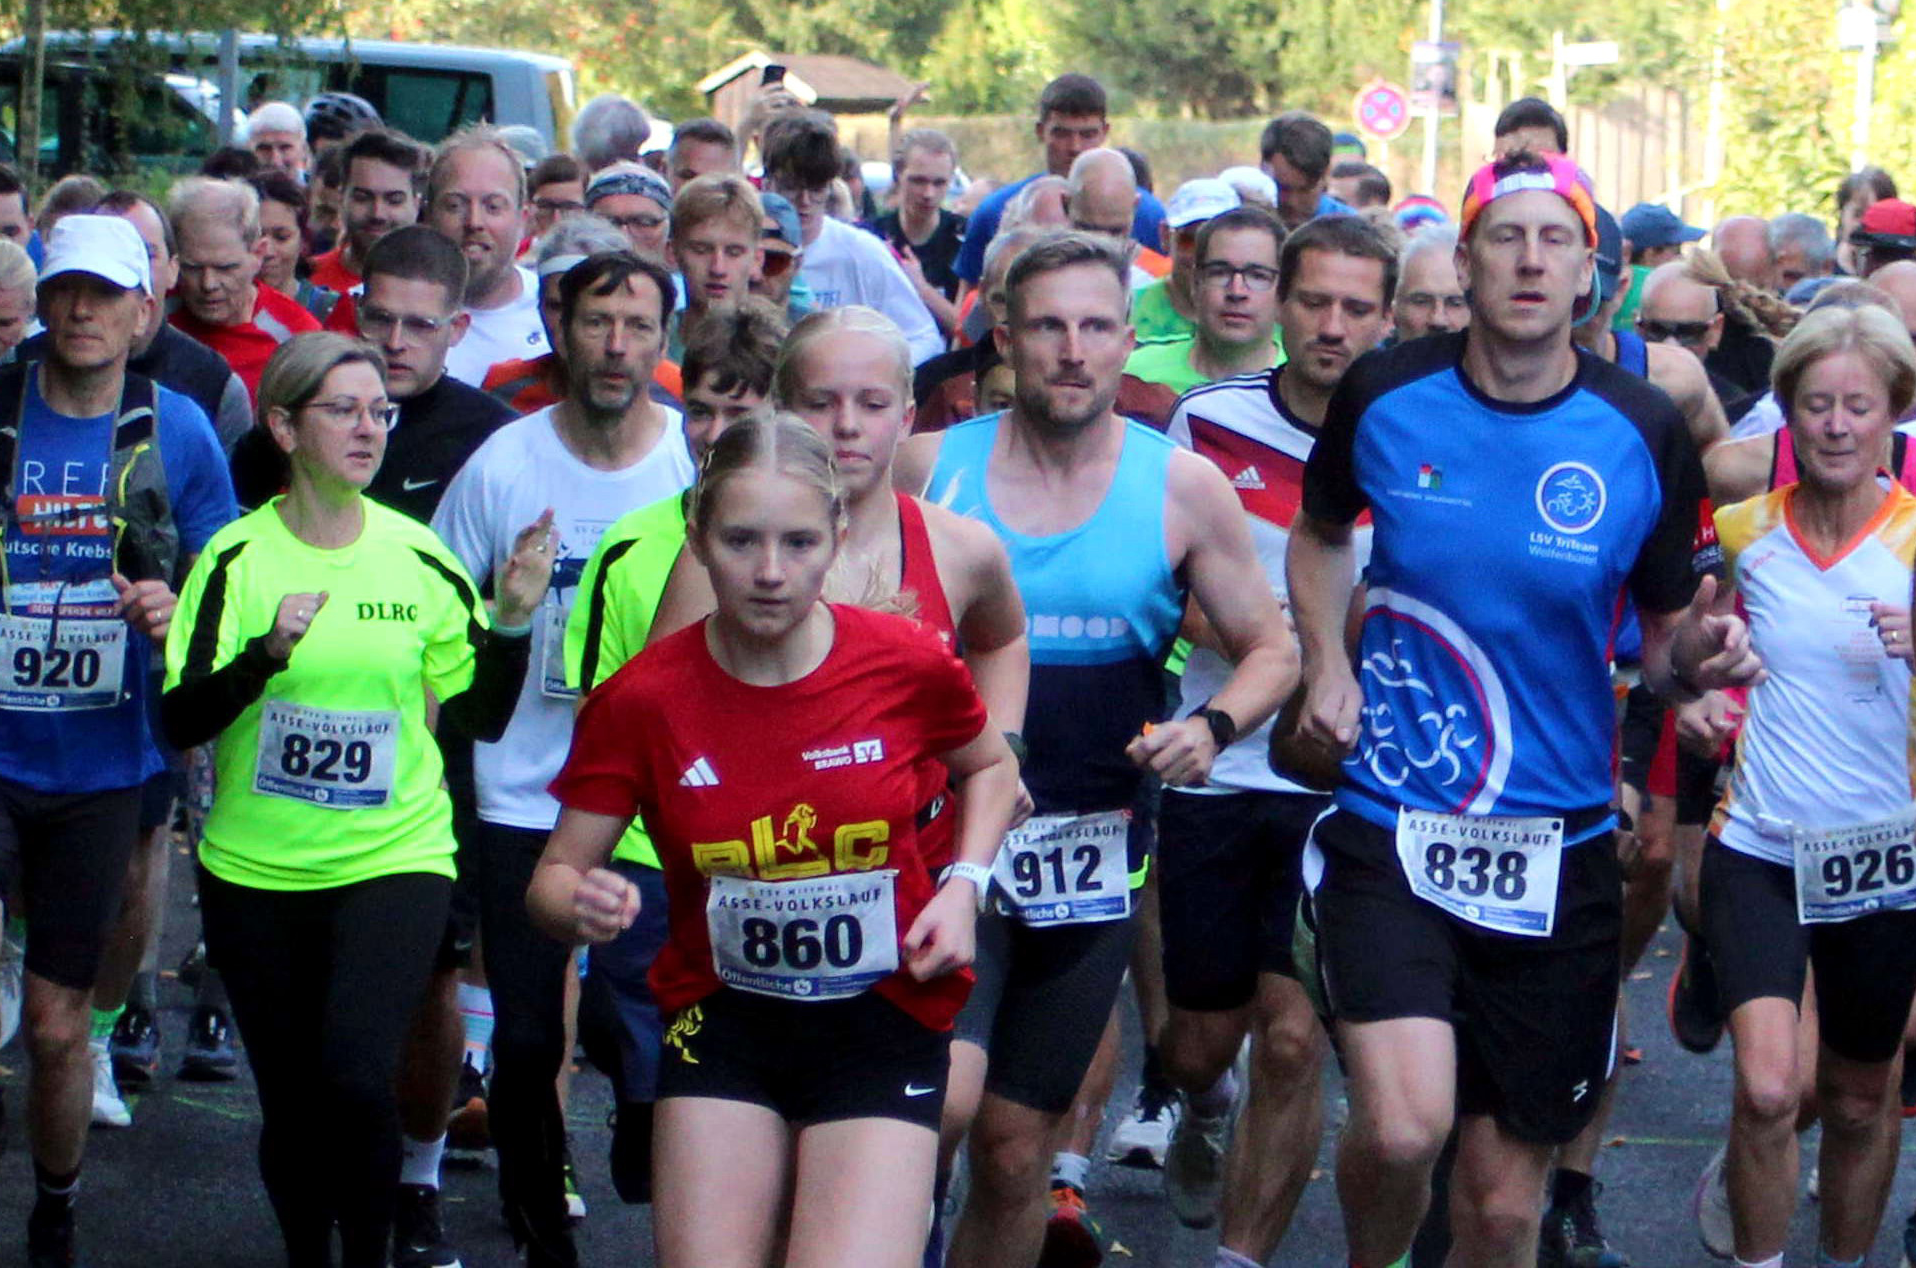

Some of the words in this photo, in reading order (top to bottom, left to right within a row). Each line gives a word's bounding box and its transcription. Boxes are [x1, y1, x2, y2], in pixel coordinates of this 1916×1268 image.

[1, 627, 118, 643] ASSE-VLKSLAUF
[13, 647, 100, 688] 920
[270, 711, 390, 735] ASSE-VOLKSLAUF
[280, 733, 372, 784] 829
[1409, 819, 1553, 847] ASSE-VOLKSLAUF
[1013, 844, 1103, 898] 912
[1425, 842, 1528, 902] 838
[1822, 843, 1915, 897] 926
[717, 887, 882, 912] ASSE-VOLKSLAUF
[742, 914, 863, 970] 860
